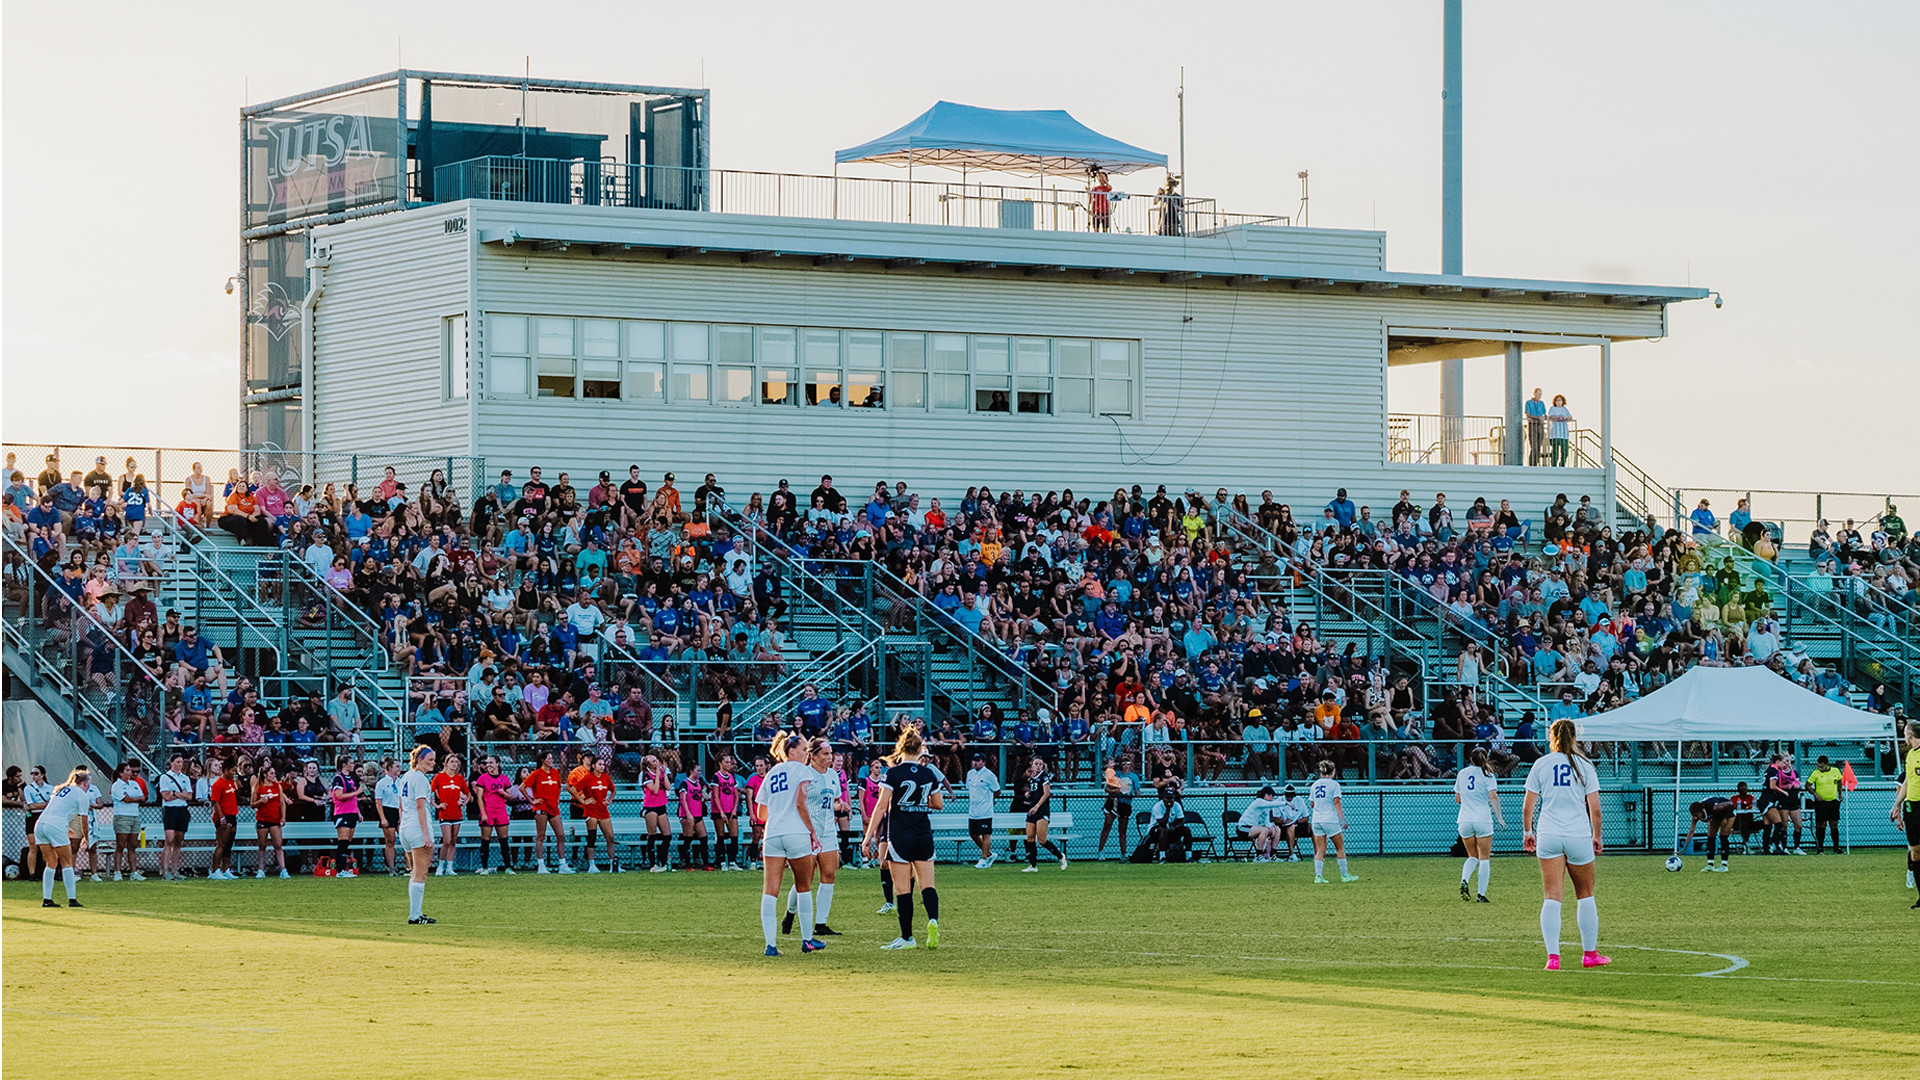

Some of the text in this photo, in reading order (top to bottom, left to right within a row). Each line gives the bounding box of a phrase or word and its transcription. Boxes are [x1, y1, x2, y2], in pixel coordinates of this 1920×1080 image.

[279, 112, 372, 177] UTSA
[770, 771, 789, 794] 22
[1467, 775, 1475, 790] 3
[1553, 763, 1571, 787] 12
[822, 796, 832, 809] 21
[896, 779, 934, 806] 21
[1315, 785, 1326, 799] 25
